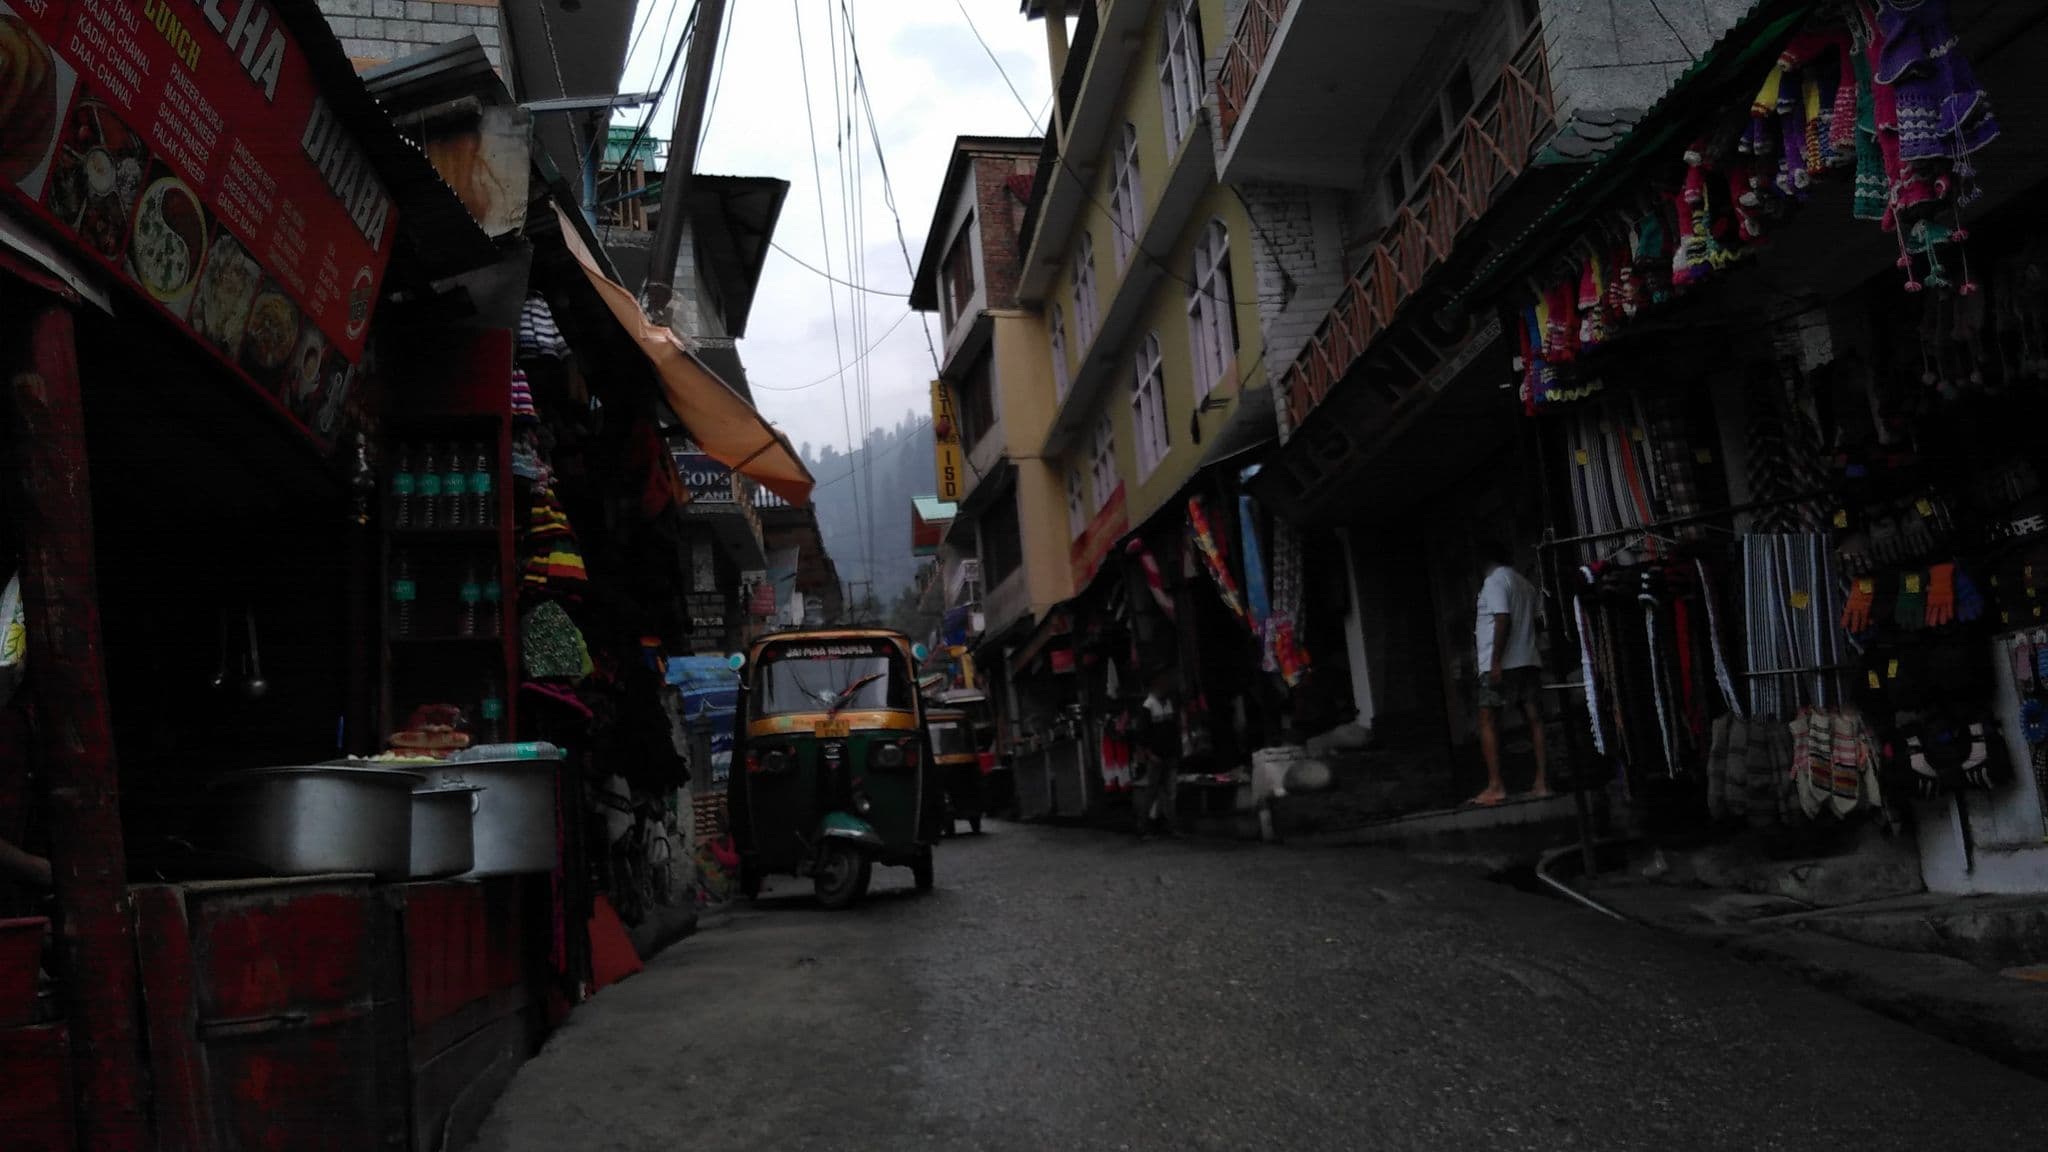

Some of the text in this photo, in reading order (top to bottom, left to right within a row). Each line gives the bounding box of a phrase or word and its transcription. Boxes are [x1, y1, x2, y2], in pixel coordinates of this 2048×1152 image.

[77, 13, 143, 93] KADHI CHAWAL
[118, 28, 151, 76] CHAWAL
[143, 0, 202, 72] LUNCH
[70, 35, 132, 111] DAAL CHAWAL
[170, 63, 200, 104] PANEER
[152, 121, 178, 157] PALAK
[301, 95, 390, 254] DHABA
[944, 450, 956, 497] ISD
